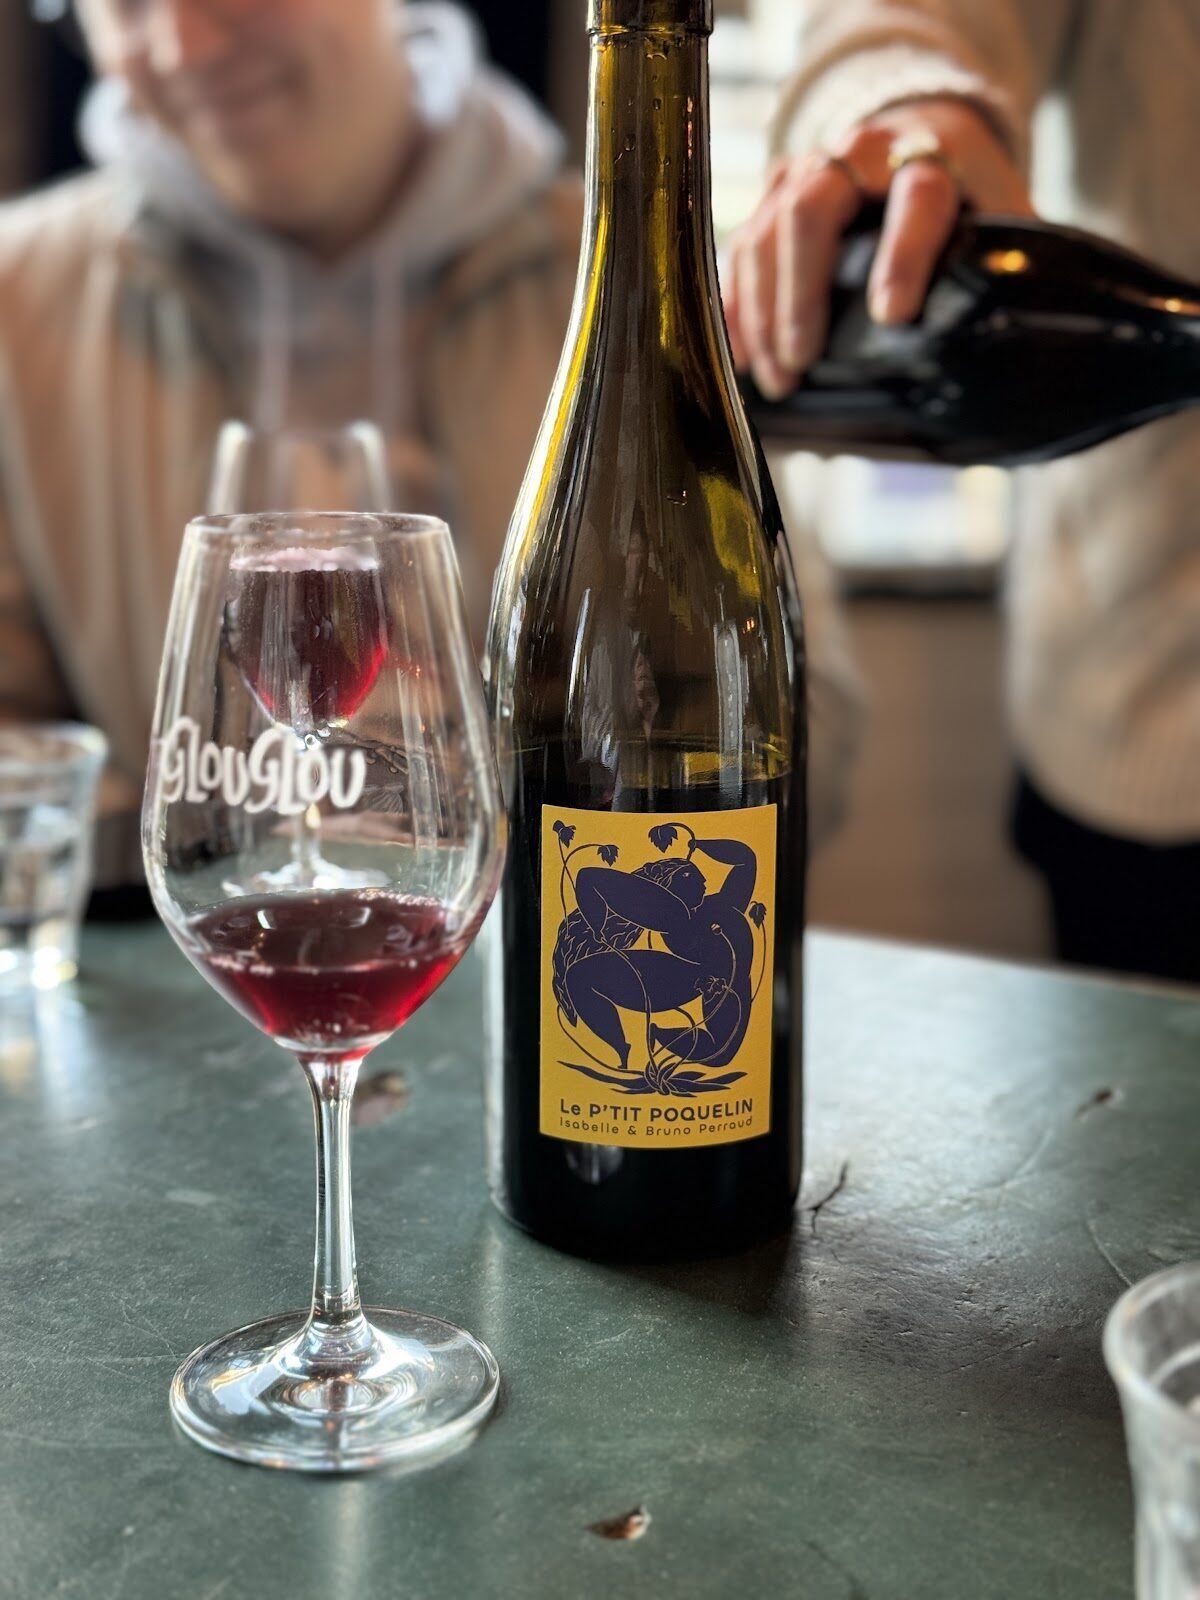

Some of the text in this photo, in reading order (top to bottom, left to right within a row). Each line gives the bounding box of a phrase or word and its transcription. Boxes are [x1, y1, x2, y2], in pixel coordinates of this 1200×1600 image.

[560, 1098, 753, 1122] Le P'TIT POQUELIN
[560, 1115, 753, 1136] Isabelle & Bruno Perraud
